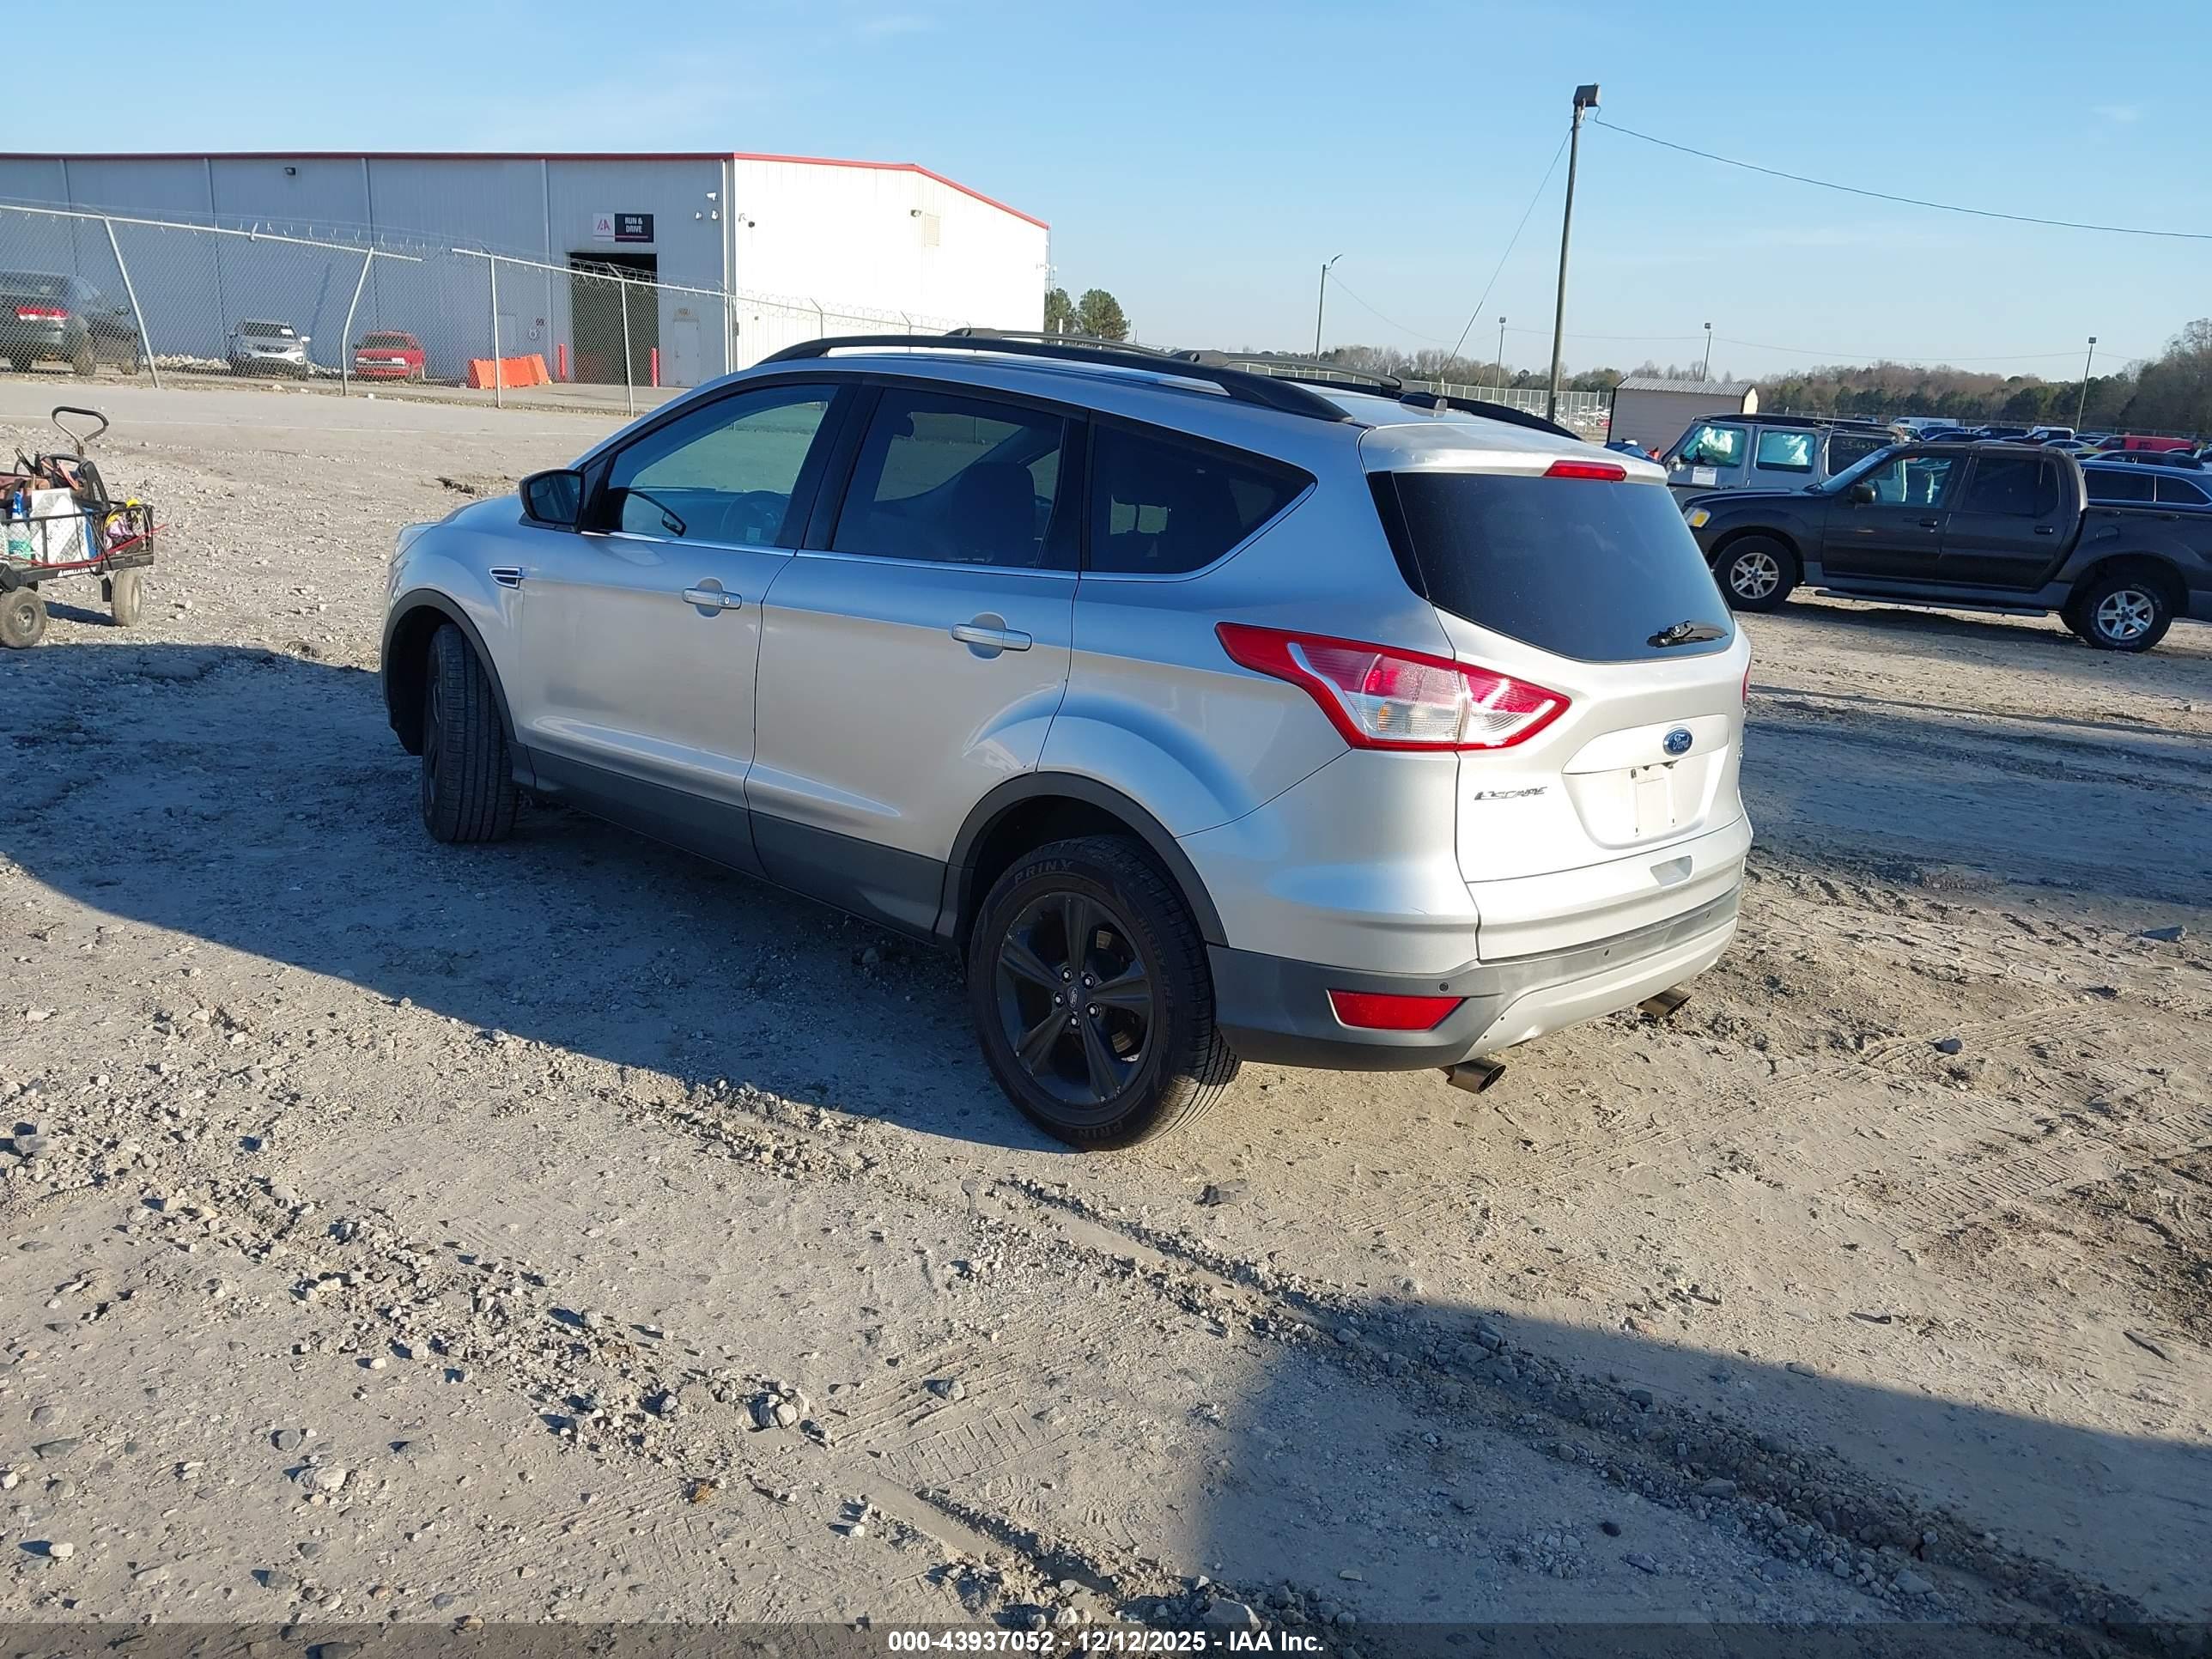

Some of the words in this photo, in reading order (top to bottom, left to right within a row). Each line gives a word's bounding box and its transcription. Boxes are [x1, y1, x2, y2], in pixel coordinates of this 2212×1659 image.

[624, 216, 637, 225] RUN
[638, 216, 643, 225] &
[625, 225, 643, 234] DRIVE
[1014, 859, 1074, 884] PRINX
